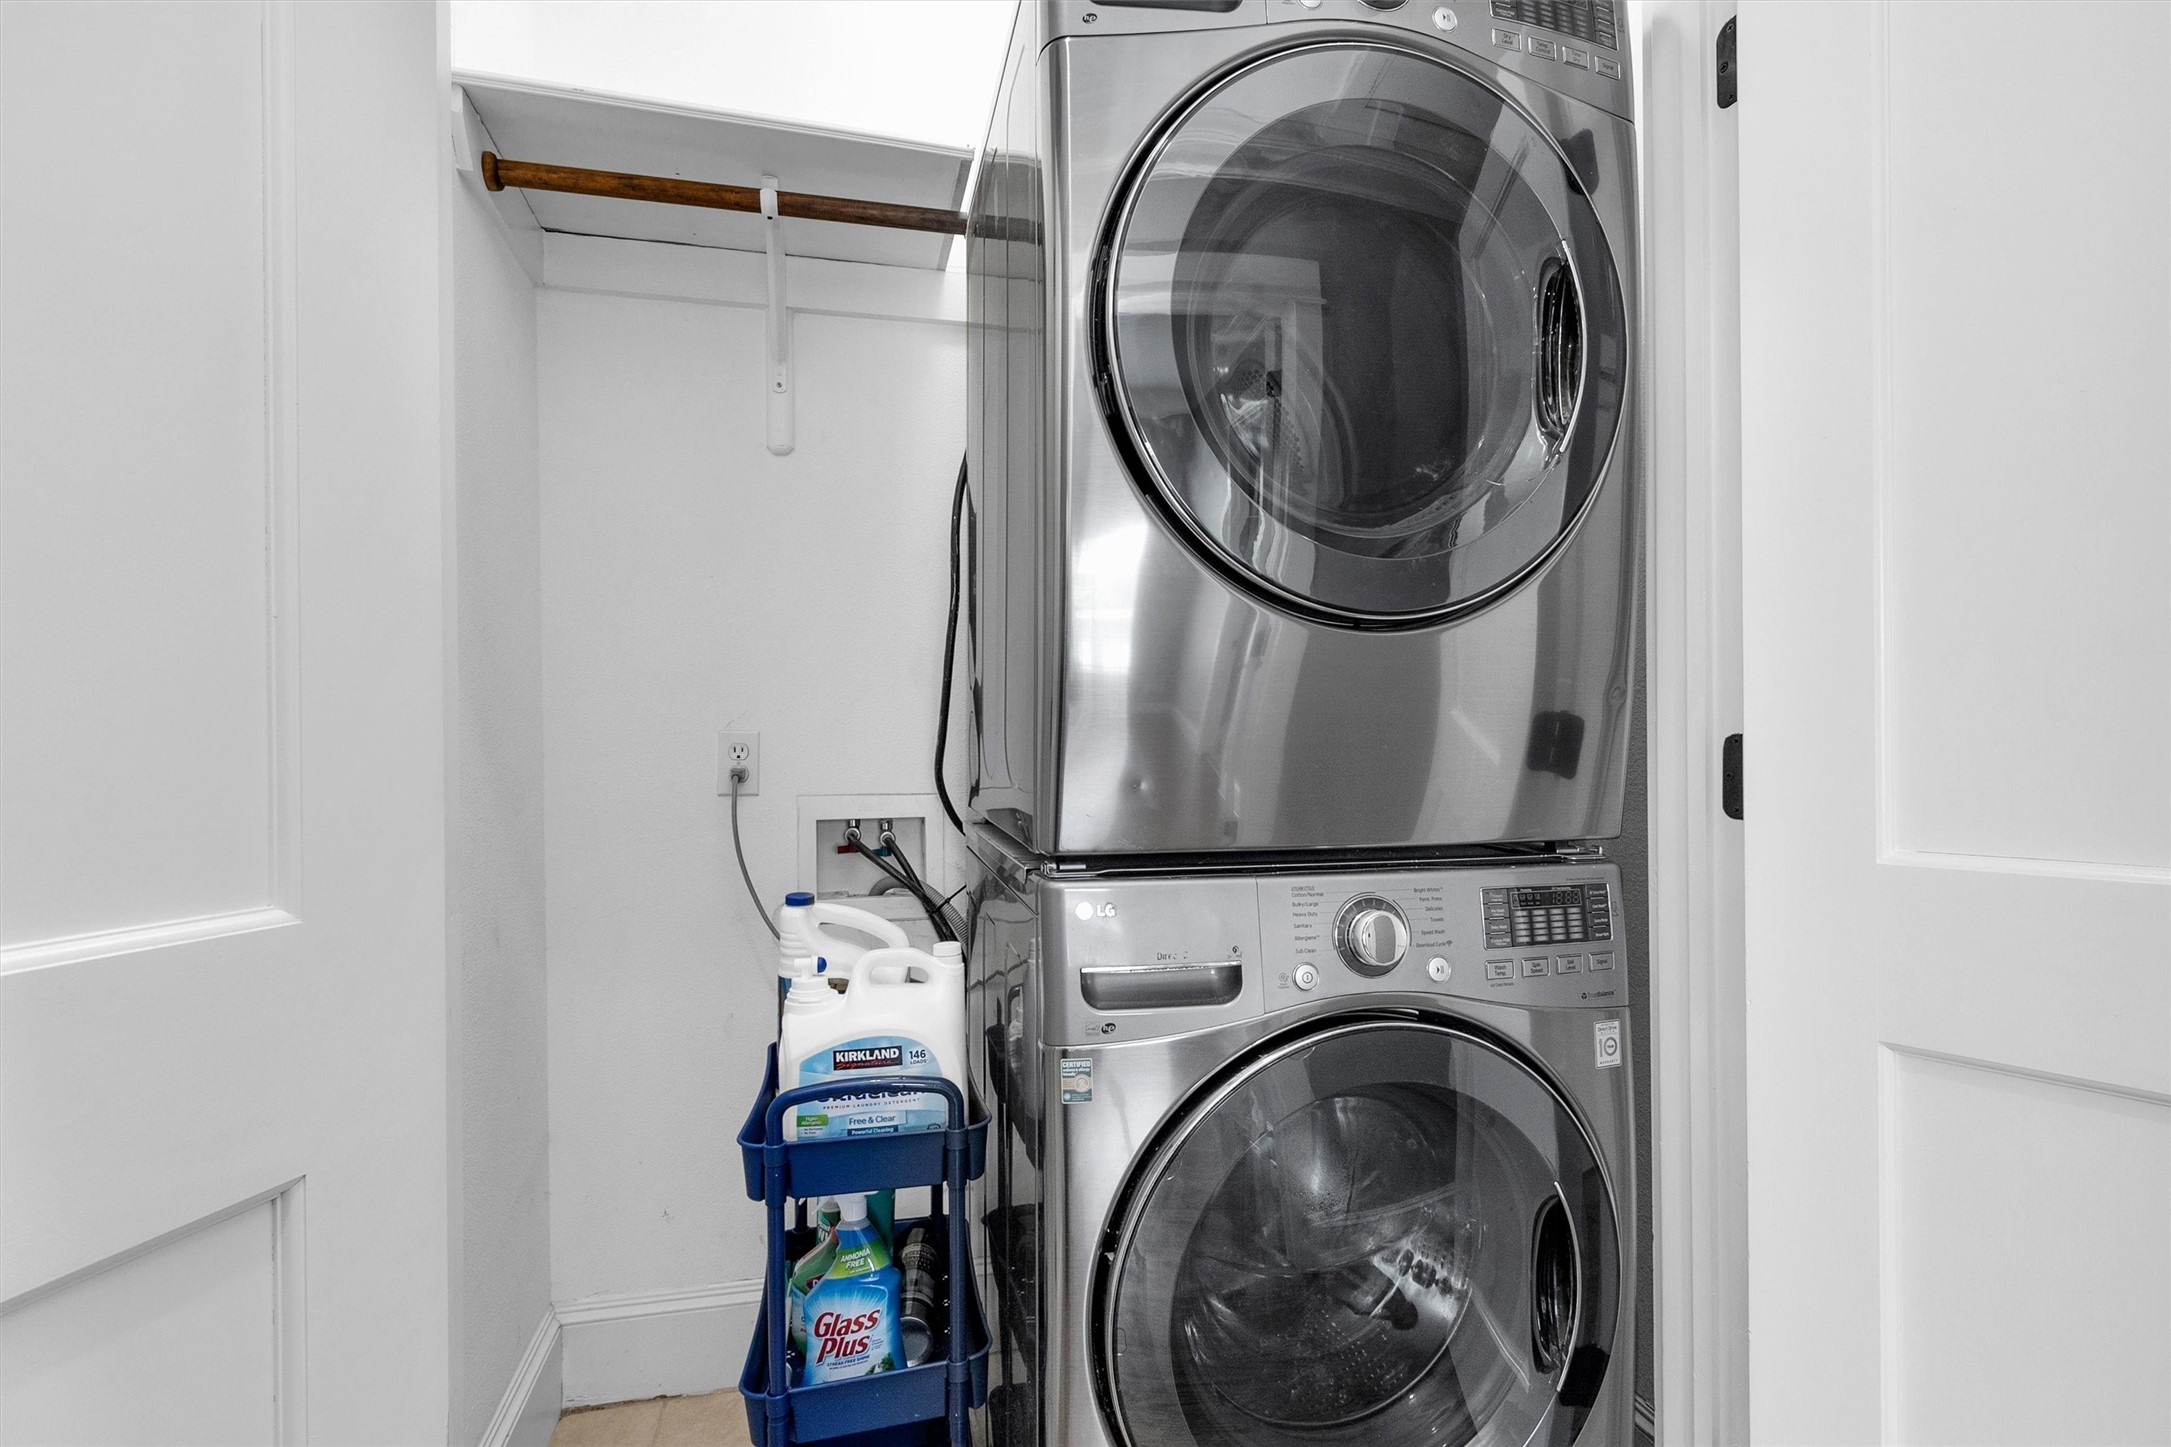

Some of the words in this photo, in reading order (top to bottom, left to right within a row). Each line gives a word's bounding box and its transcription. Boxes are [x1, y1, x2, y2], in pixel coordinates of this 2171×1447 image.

[1096, 903, 1116, 917] LG
[835, 1048, 900, 1062] KIRKLAND
[909, 1049, 926, 1060] 146
[835, 1060, 899, 1070] Signature
[884, 1097, 921, 1106] DETERGENT
[848, 1117, 867, 1126] Free
[868, 1116, 874, 1124] &
[875, 1114, 896, 1123] Clear
[851, 1128, 873, 1136] Powerful
[840, 1247, 871, 1263] AMMONIA
[845, 1258, 865, 1269] FREE
[814, 1309, 881, 1338] Glass
[816, 1335, 870, 1365] Plus
